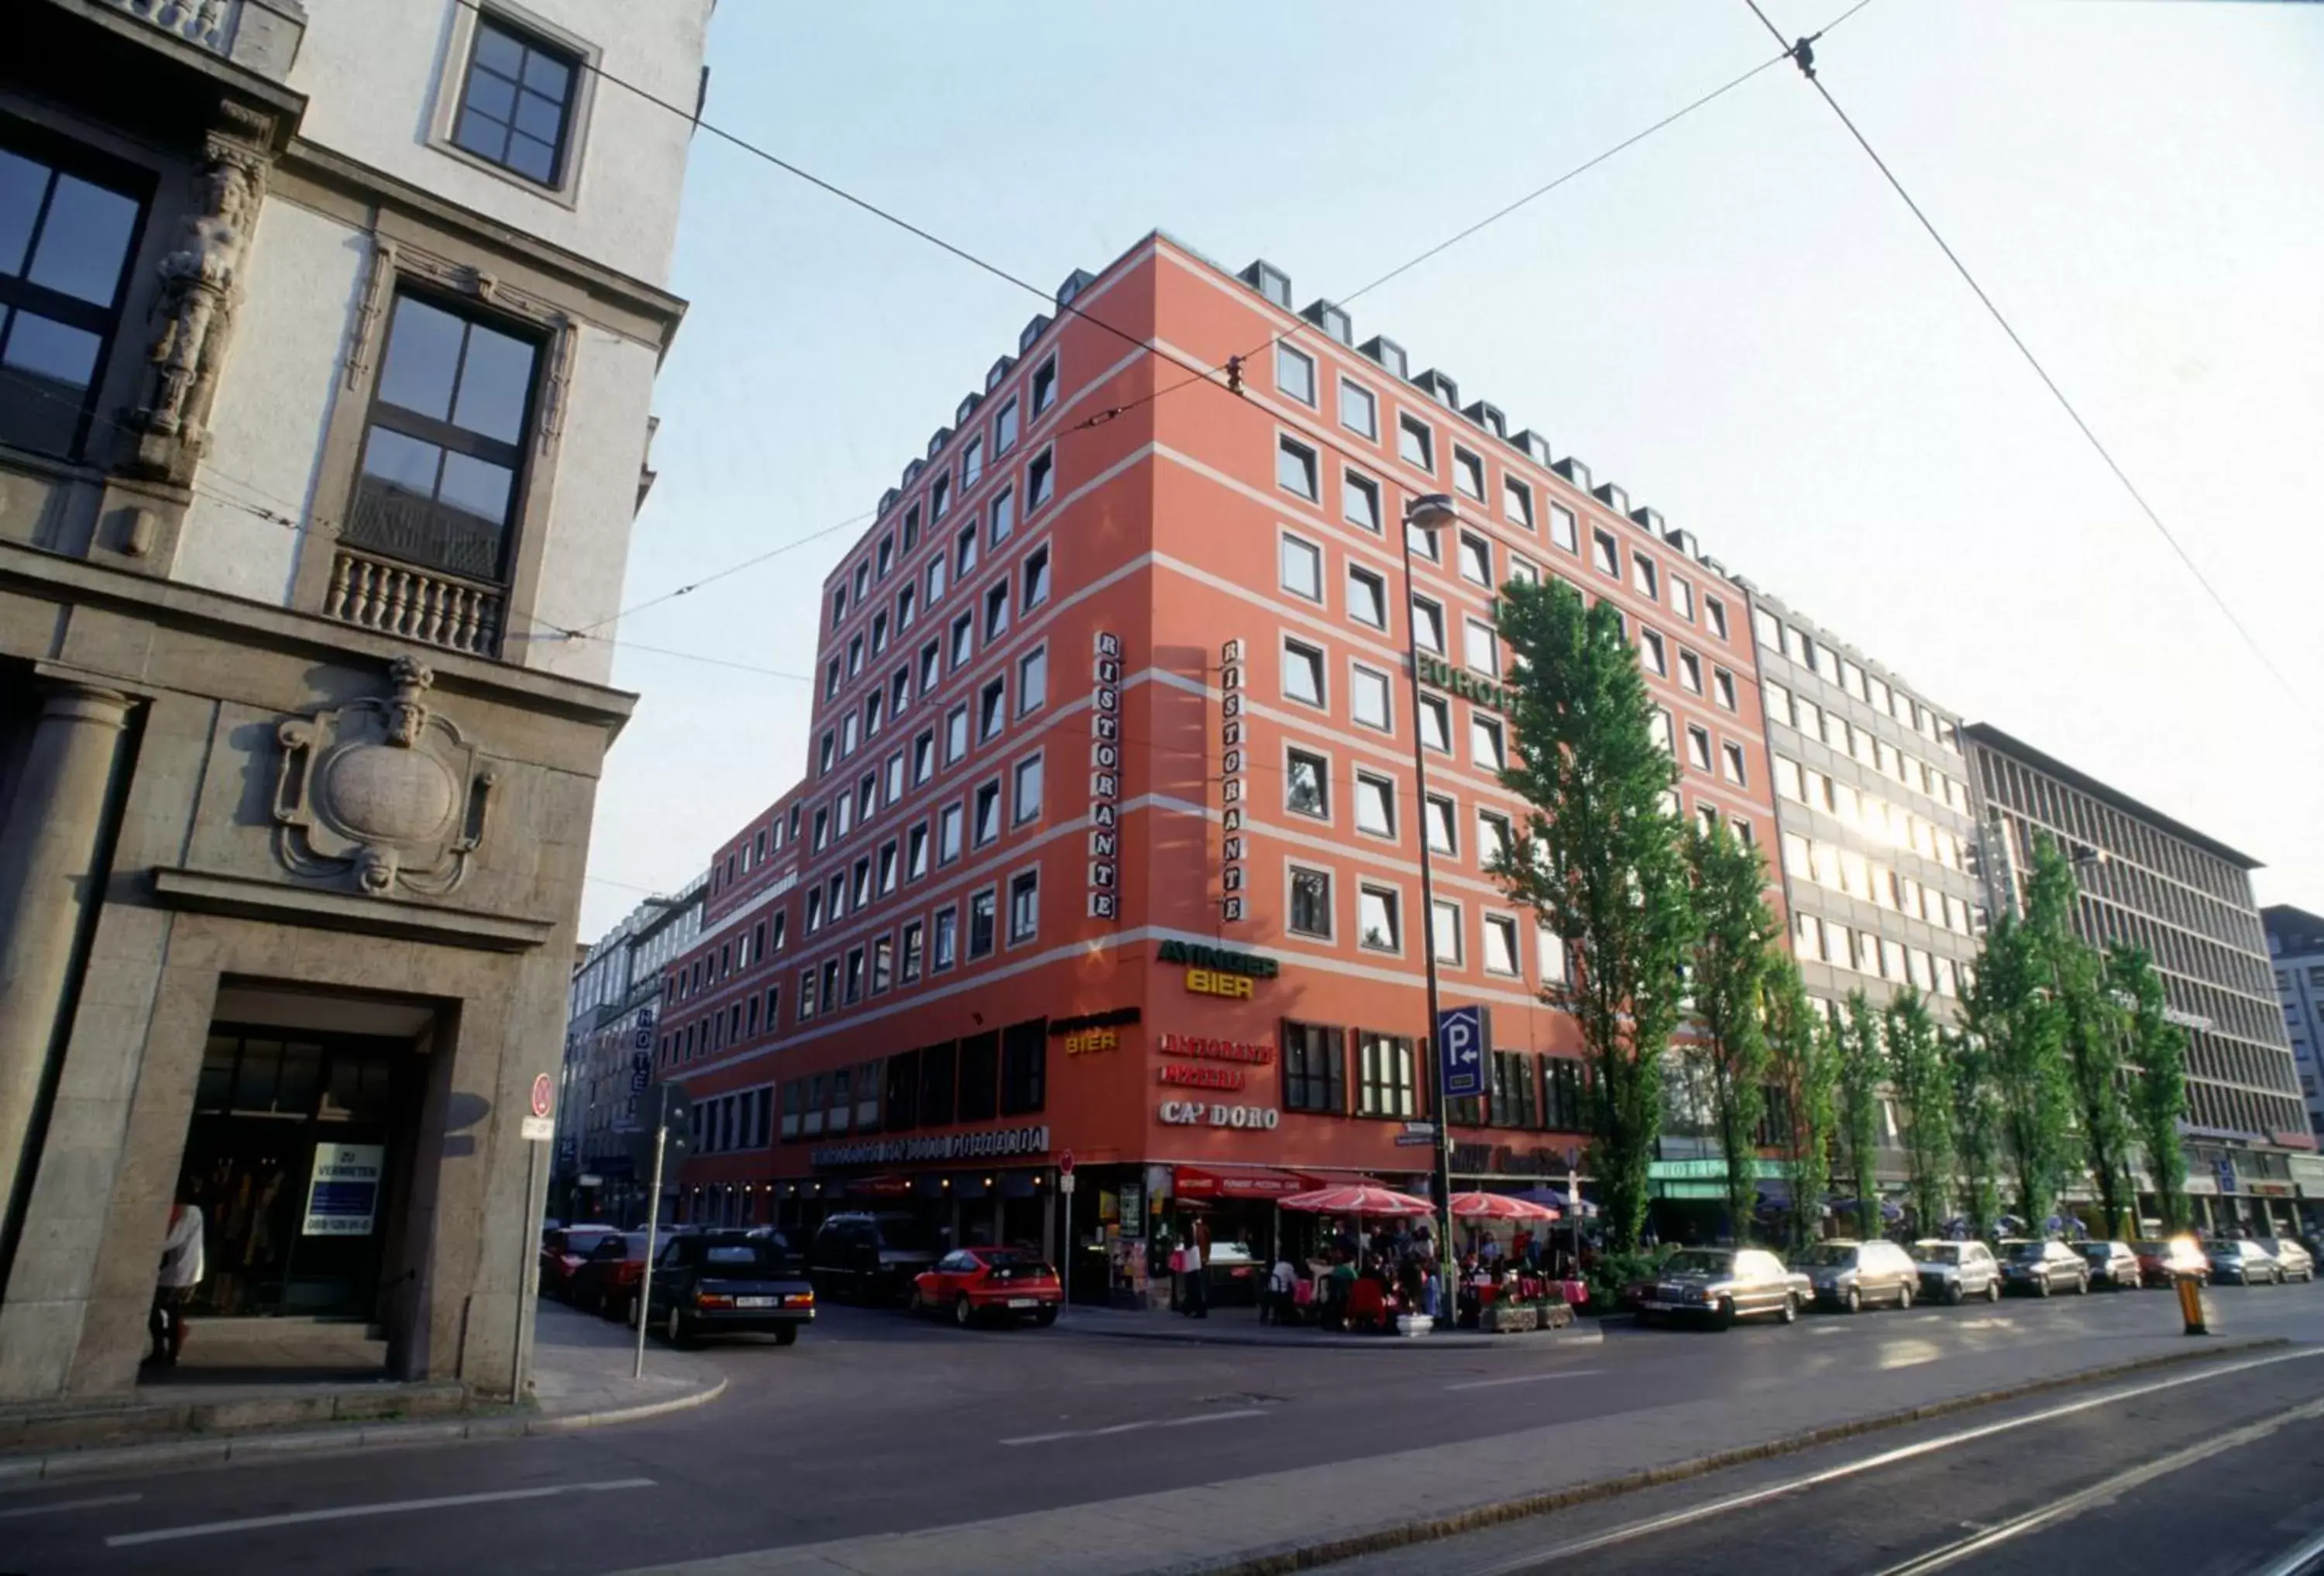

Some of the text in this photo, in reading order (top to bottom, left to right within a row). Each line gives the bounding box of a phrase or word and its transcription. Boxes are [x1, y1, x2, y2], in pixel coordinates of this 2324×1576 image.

[1093, 634, 1118, 916] RISTORANTE
[1222, 641, 1242, 920] RISTORANTE
[1186, 969, 1253, 1000] BIER
[1065, 1031, 1118, 1055] BIER
[1449, 1024, 1470, 1066] P
[1160, 1100, 1279, 1130] CA' DORO
[952, 1126, 1044, 1158] PIZZERIA
